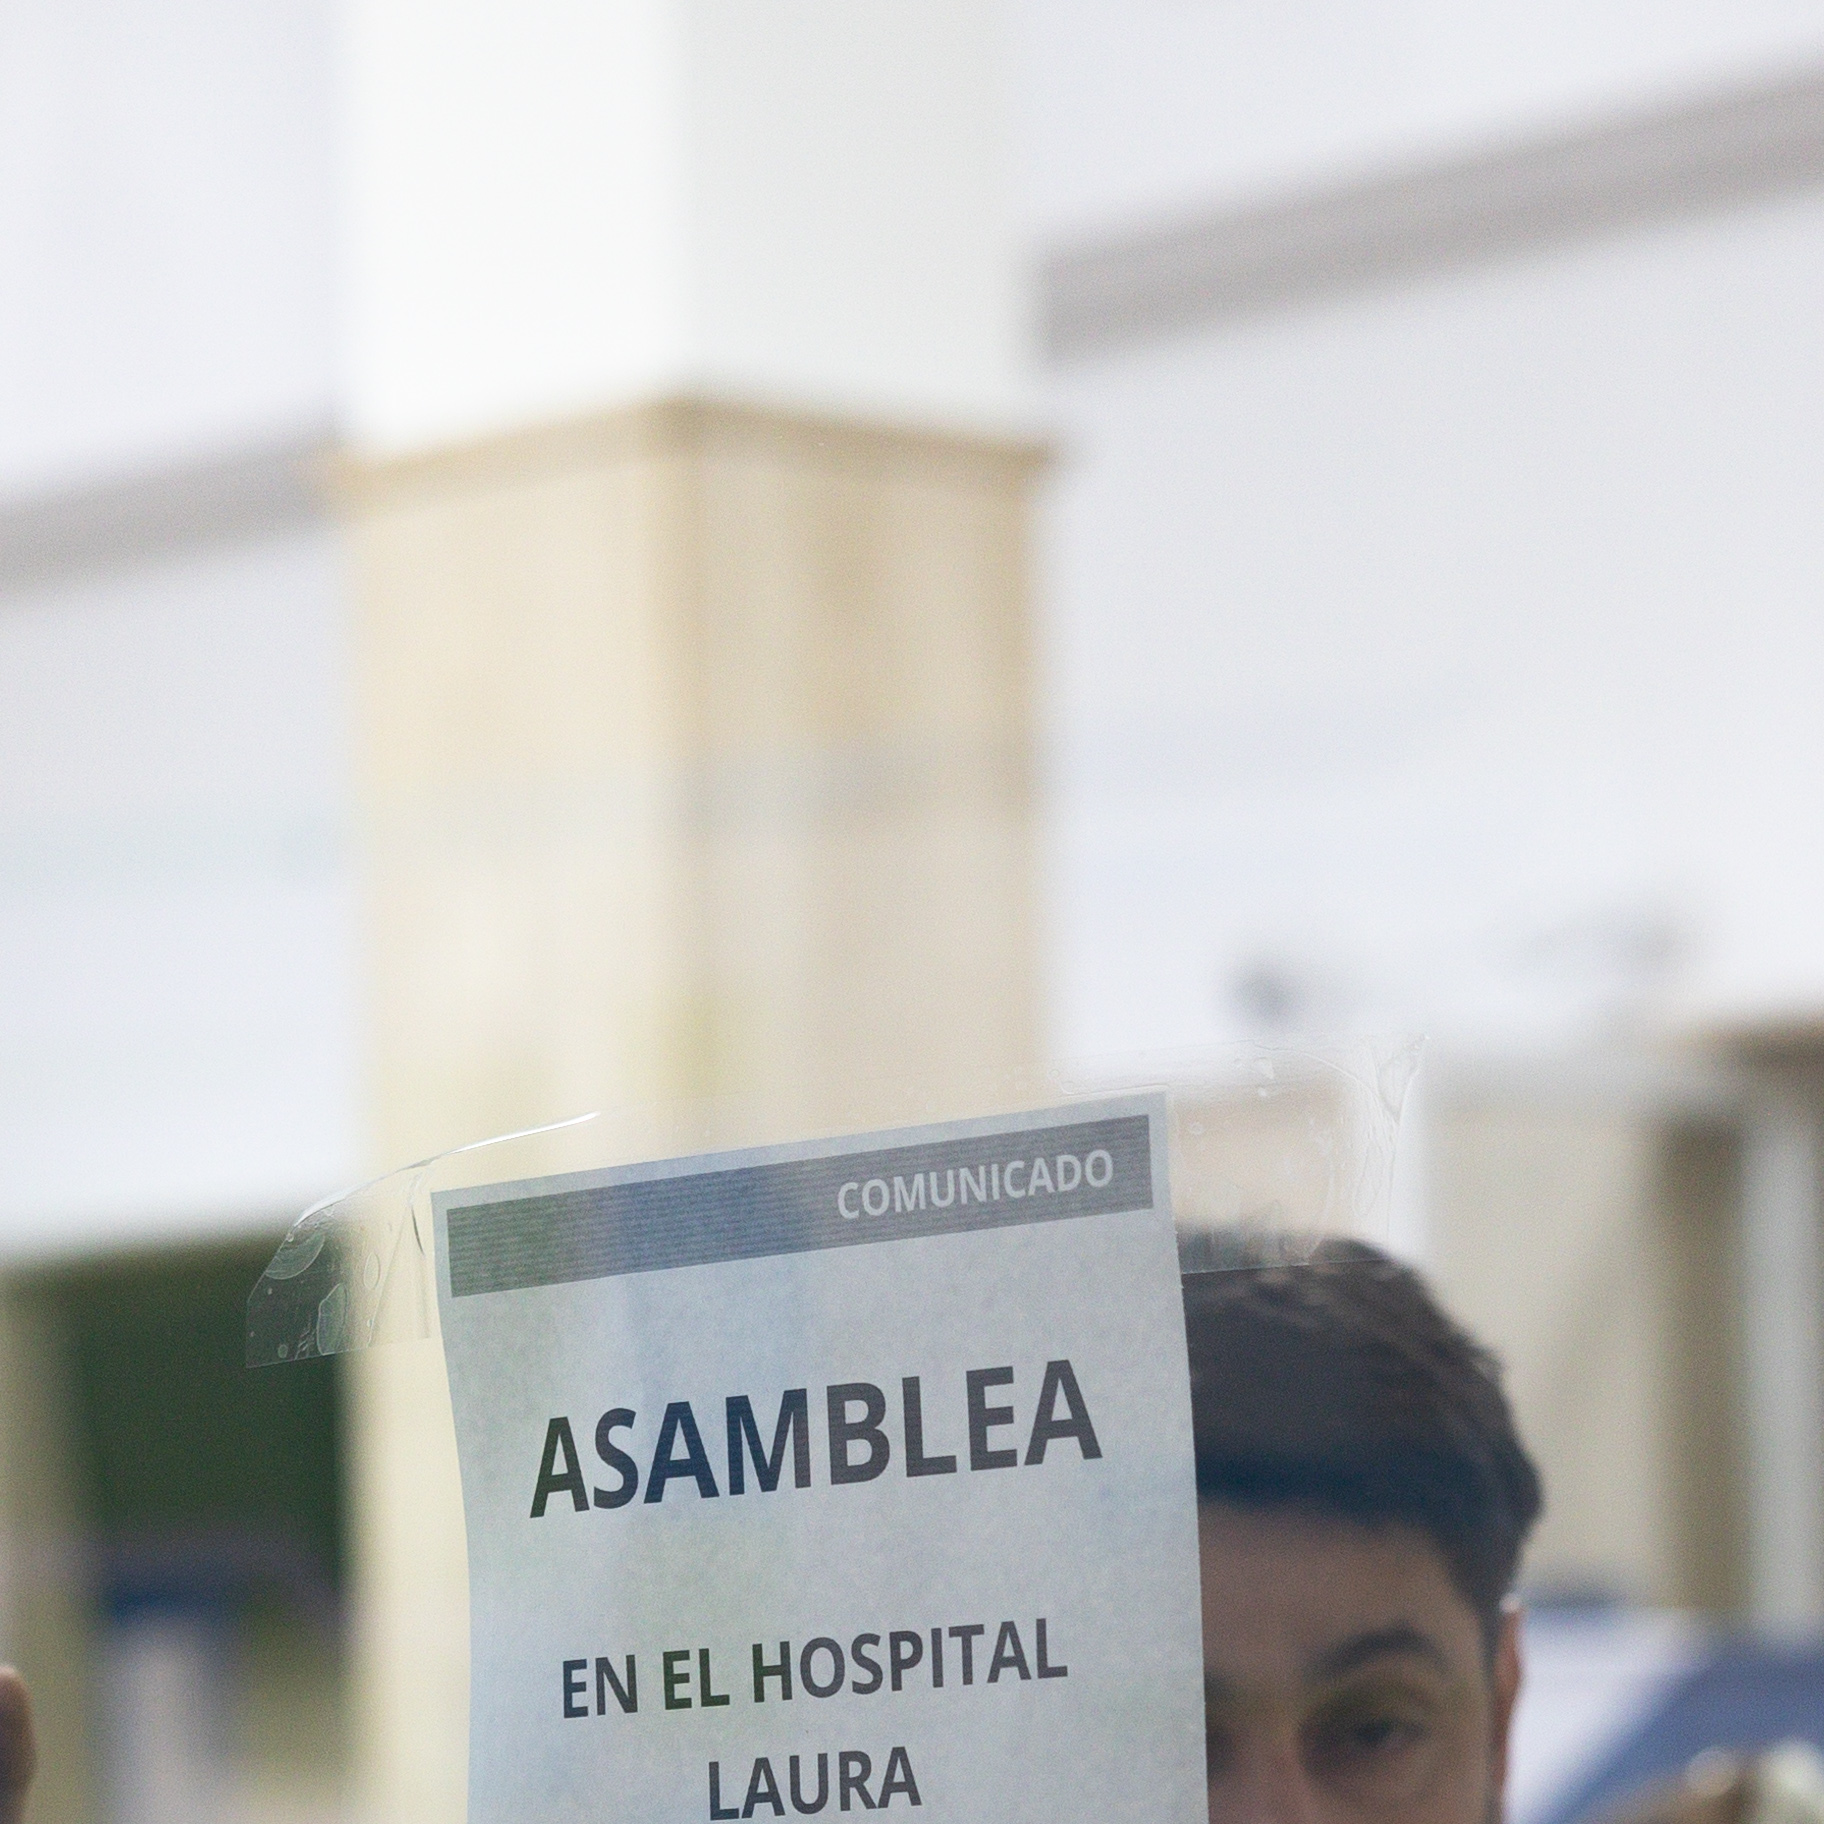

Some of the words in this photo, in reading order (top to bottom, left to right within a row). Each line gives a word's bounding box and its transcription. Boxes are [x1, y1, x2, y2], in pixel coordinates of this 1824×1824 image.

[836, 1146, 1114, 1221] COMUNICADO
[529, 1358, 1103, 1519] ASAMBLEA
[561, 1653, 639, 1719] EN
[662, 1647, 731, 1711] EL
[751, 1617, 1069, 1704] HOSPITAL
[707, 1745, 923, 1822] LAURA
